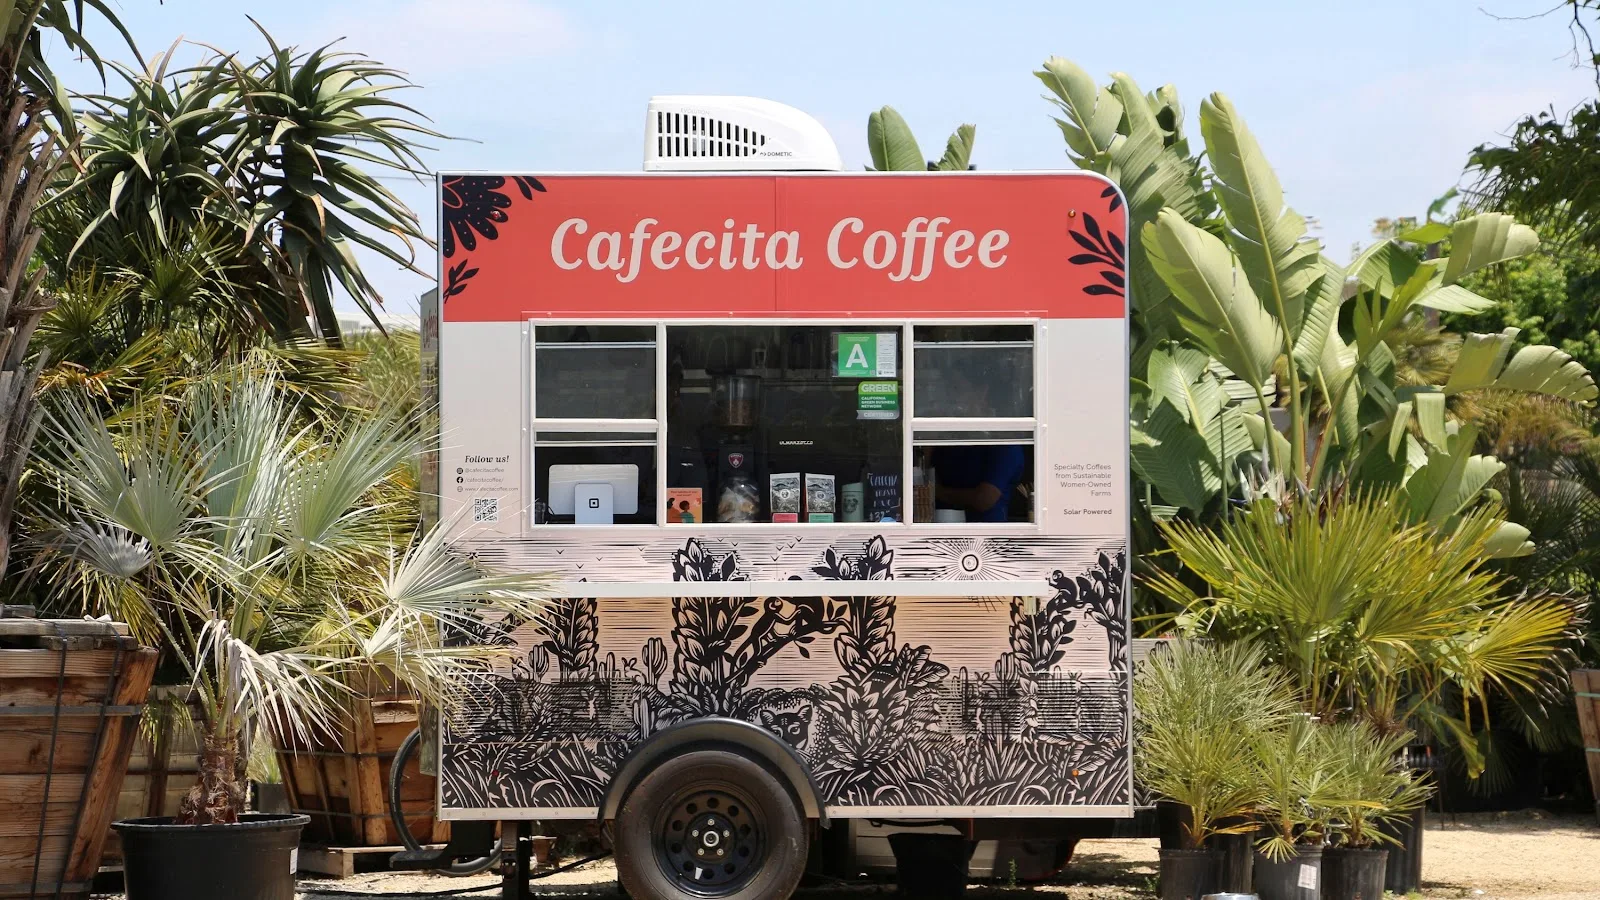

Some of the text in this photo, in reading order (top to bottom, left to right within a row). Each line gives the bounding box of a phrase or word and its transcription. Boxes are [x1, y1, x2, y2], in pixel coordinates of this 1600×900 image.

[550, 216, 1010, 283] Cafecita Coffee
[845, 343, 869, 368] A
[861, 383, 896, 393] GREEN
[465, 455, 510, 463] Follow us!
[1054, 463, 1084, 471] Specialty
